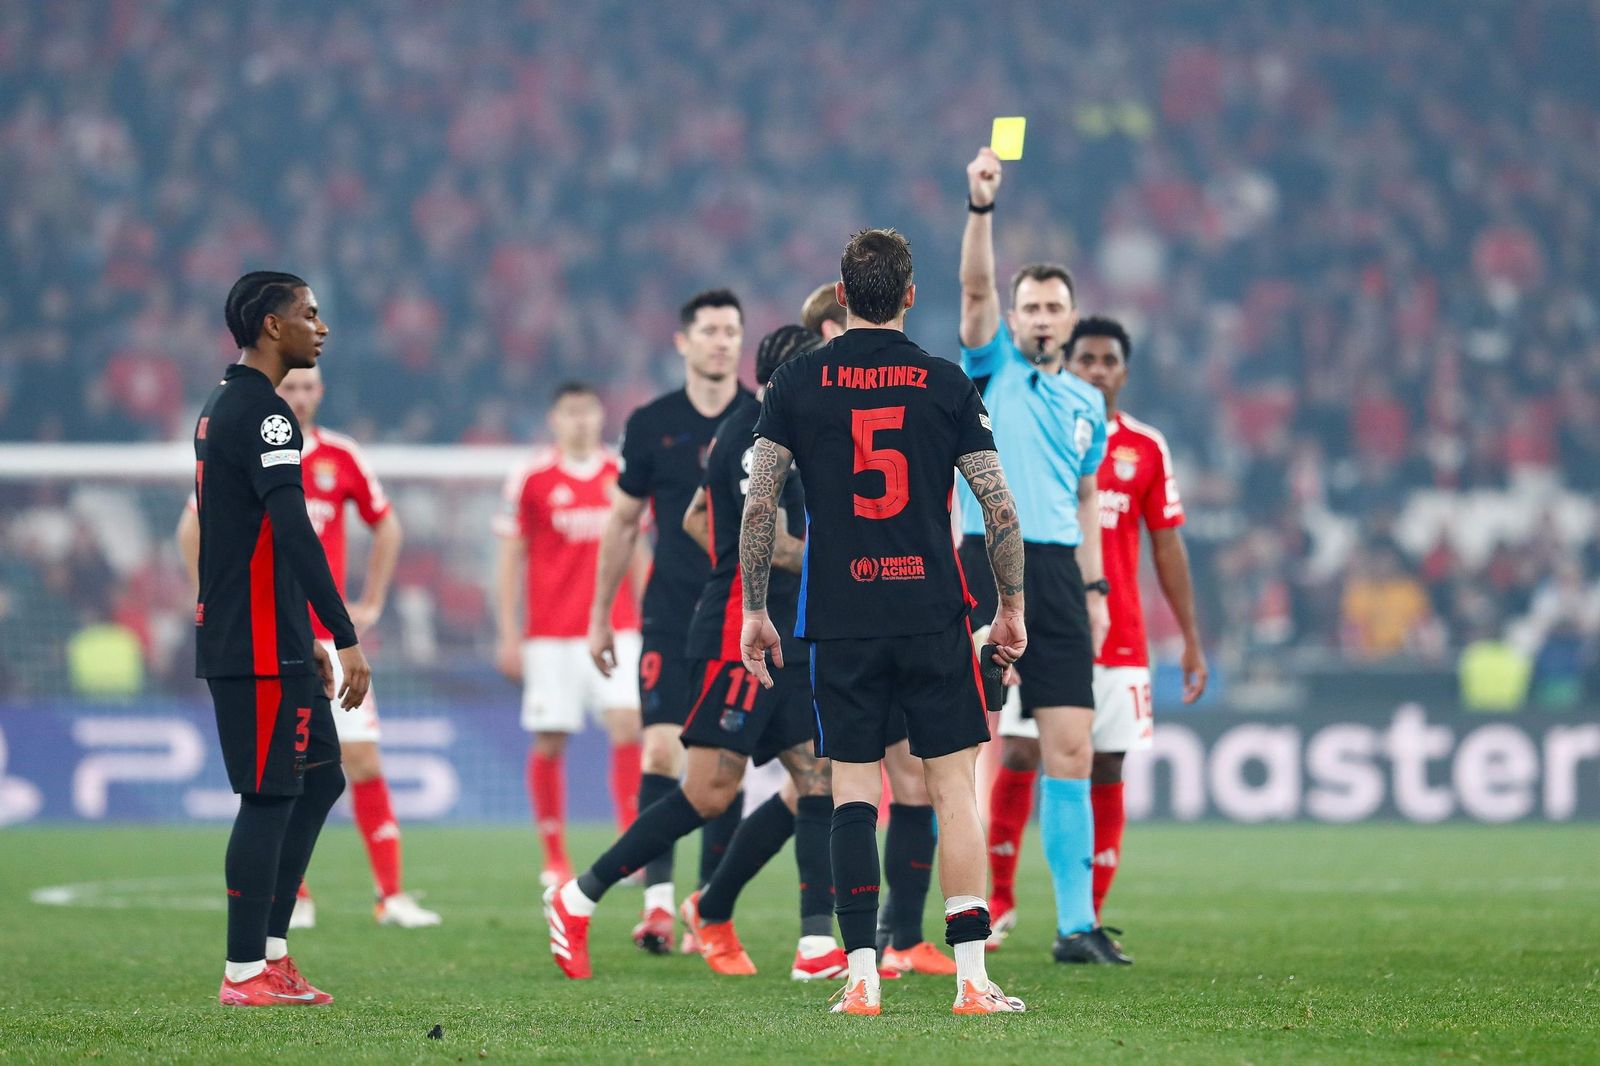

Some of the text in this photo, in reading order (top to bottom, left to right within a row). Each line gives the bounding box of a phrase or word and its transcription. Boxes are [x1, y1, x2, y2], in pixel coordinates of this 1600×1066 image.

[837, 365, 928, 390] MARTINEZ
[850, 405, 910, 520] 5
[880, 556, 924, 567] UNHCR
[881, 566, 925, 577] ACNUR
[640, 651, 662, 691] 9
[725, 666, 760, 712] 11
[294, 707, 312, 752] 3
